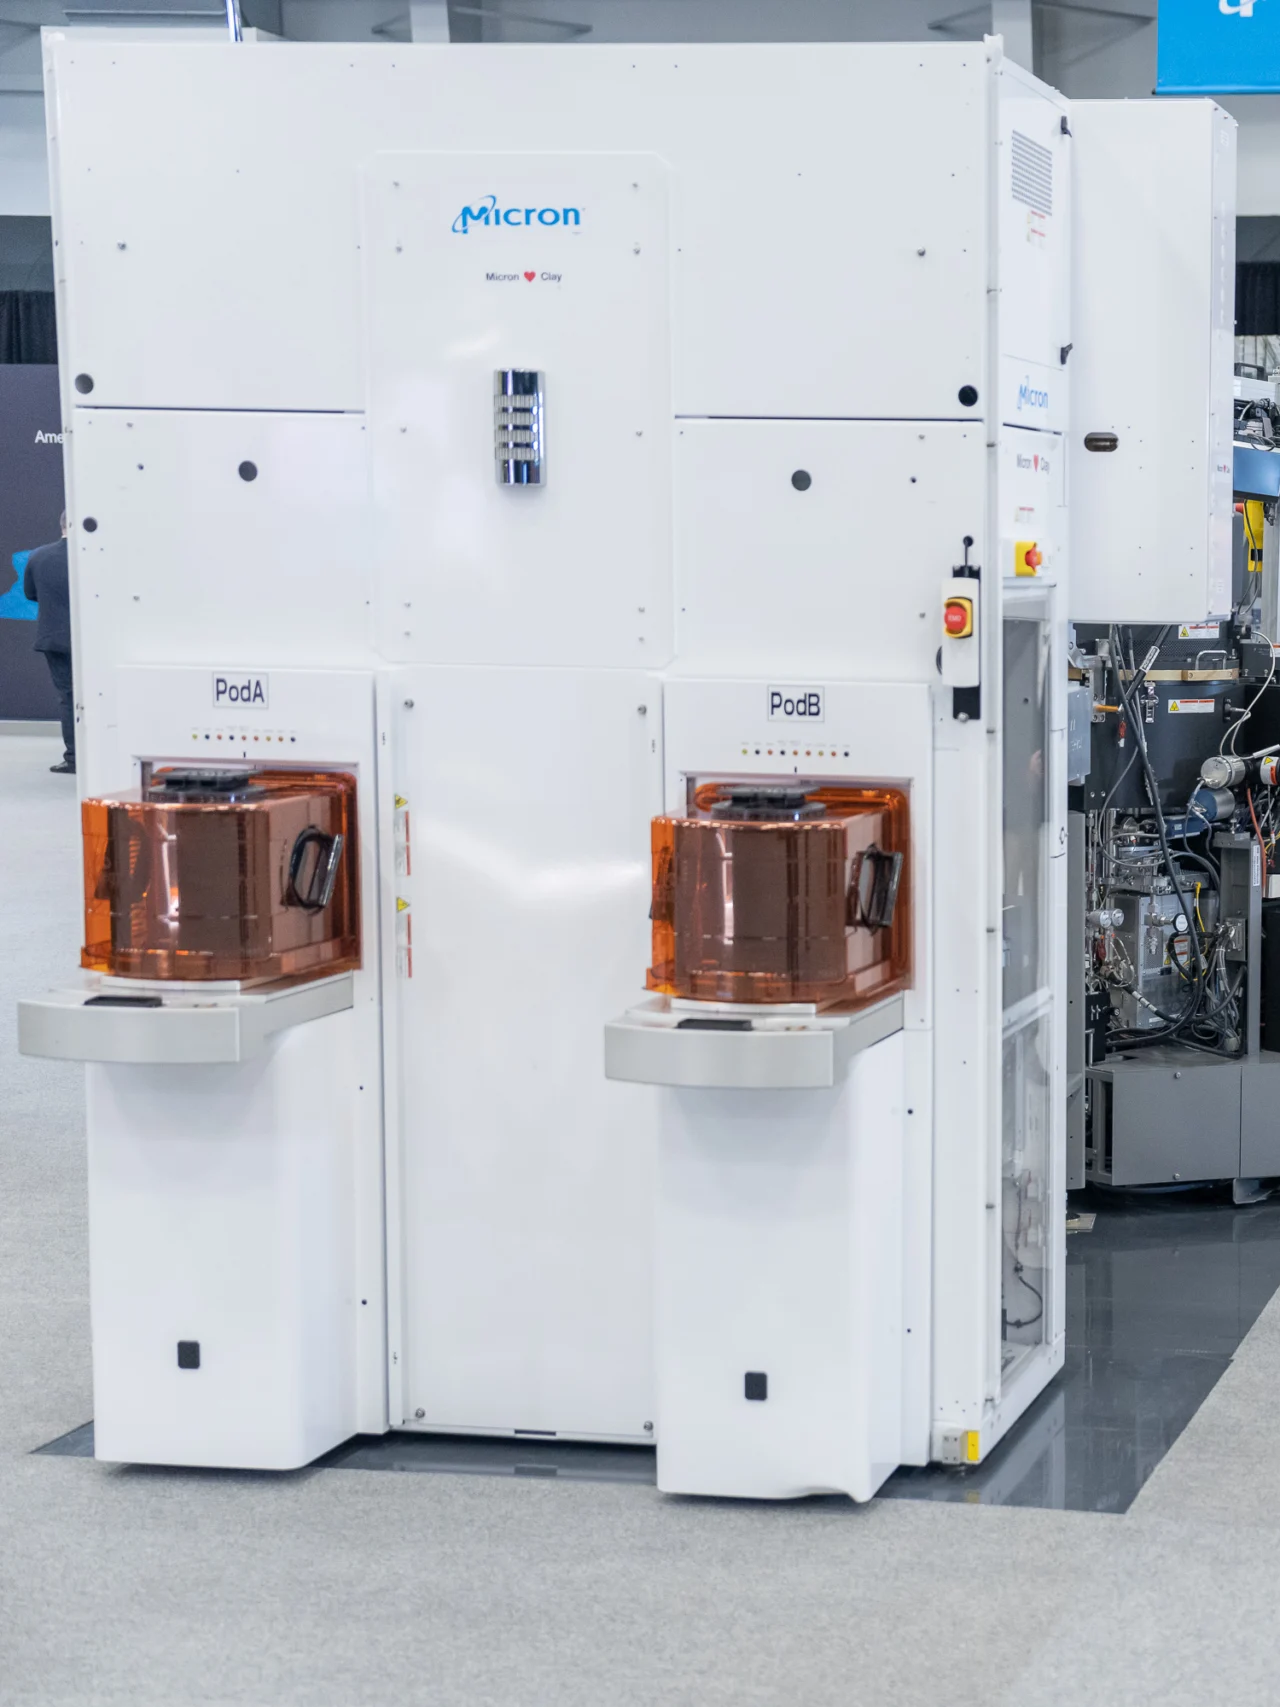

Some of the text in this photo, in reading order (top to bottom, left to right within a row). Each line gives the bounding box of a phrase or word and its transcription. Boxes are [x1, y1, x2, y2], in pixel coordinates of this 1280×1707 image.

[456, 199, 581, 234] Micron
[485, 271, 562, 283] Micron Clay
[1018, 382, 1048, 410] Micron
[215, 678, 264, 703] PodA
[771, 691, 821, 717] PodB
